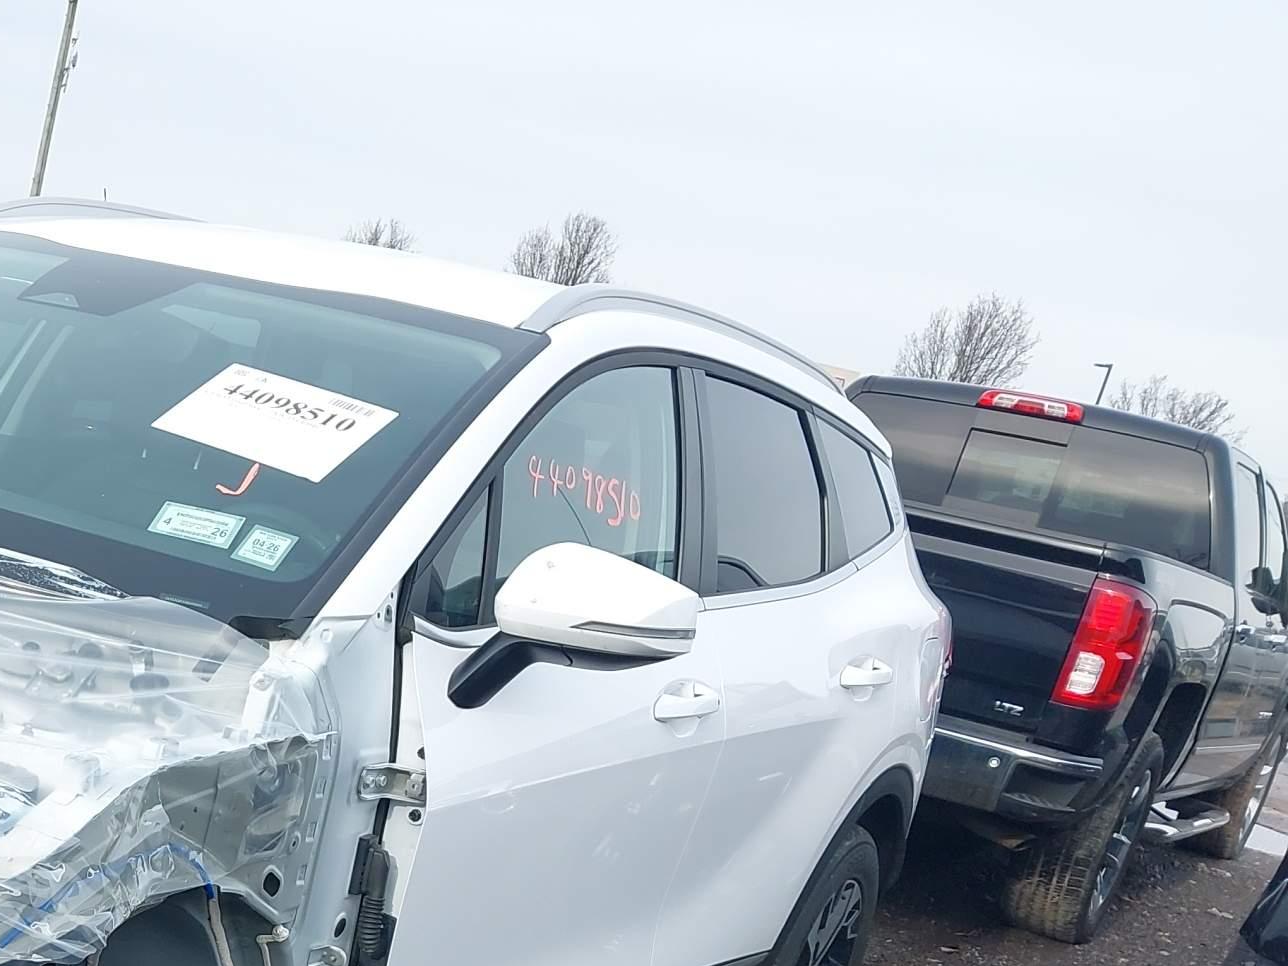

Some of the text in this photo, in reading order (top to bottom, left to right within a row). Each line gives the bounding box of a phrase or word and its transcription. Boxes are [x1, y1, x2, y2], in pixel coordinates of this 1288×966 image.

[224, 384, 357, 432] 44098510
[528, 455, 641, 527] 44098510
[211, 527, 229, 538] 26
[994, 700, 1024, 716] LTZ
